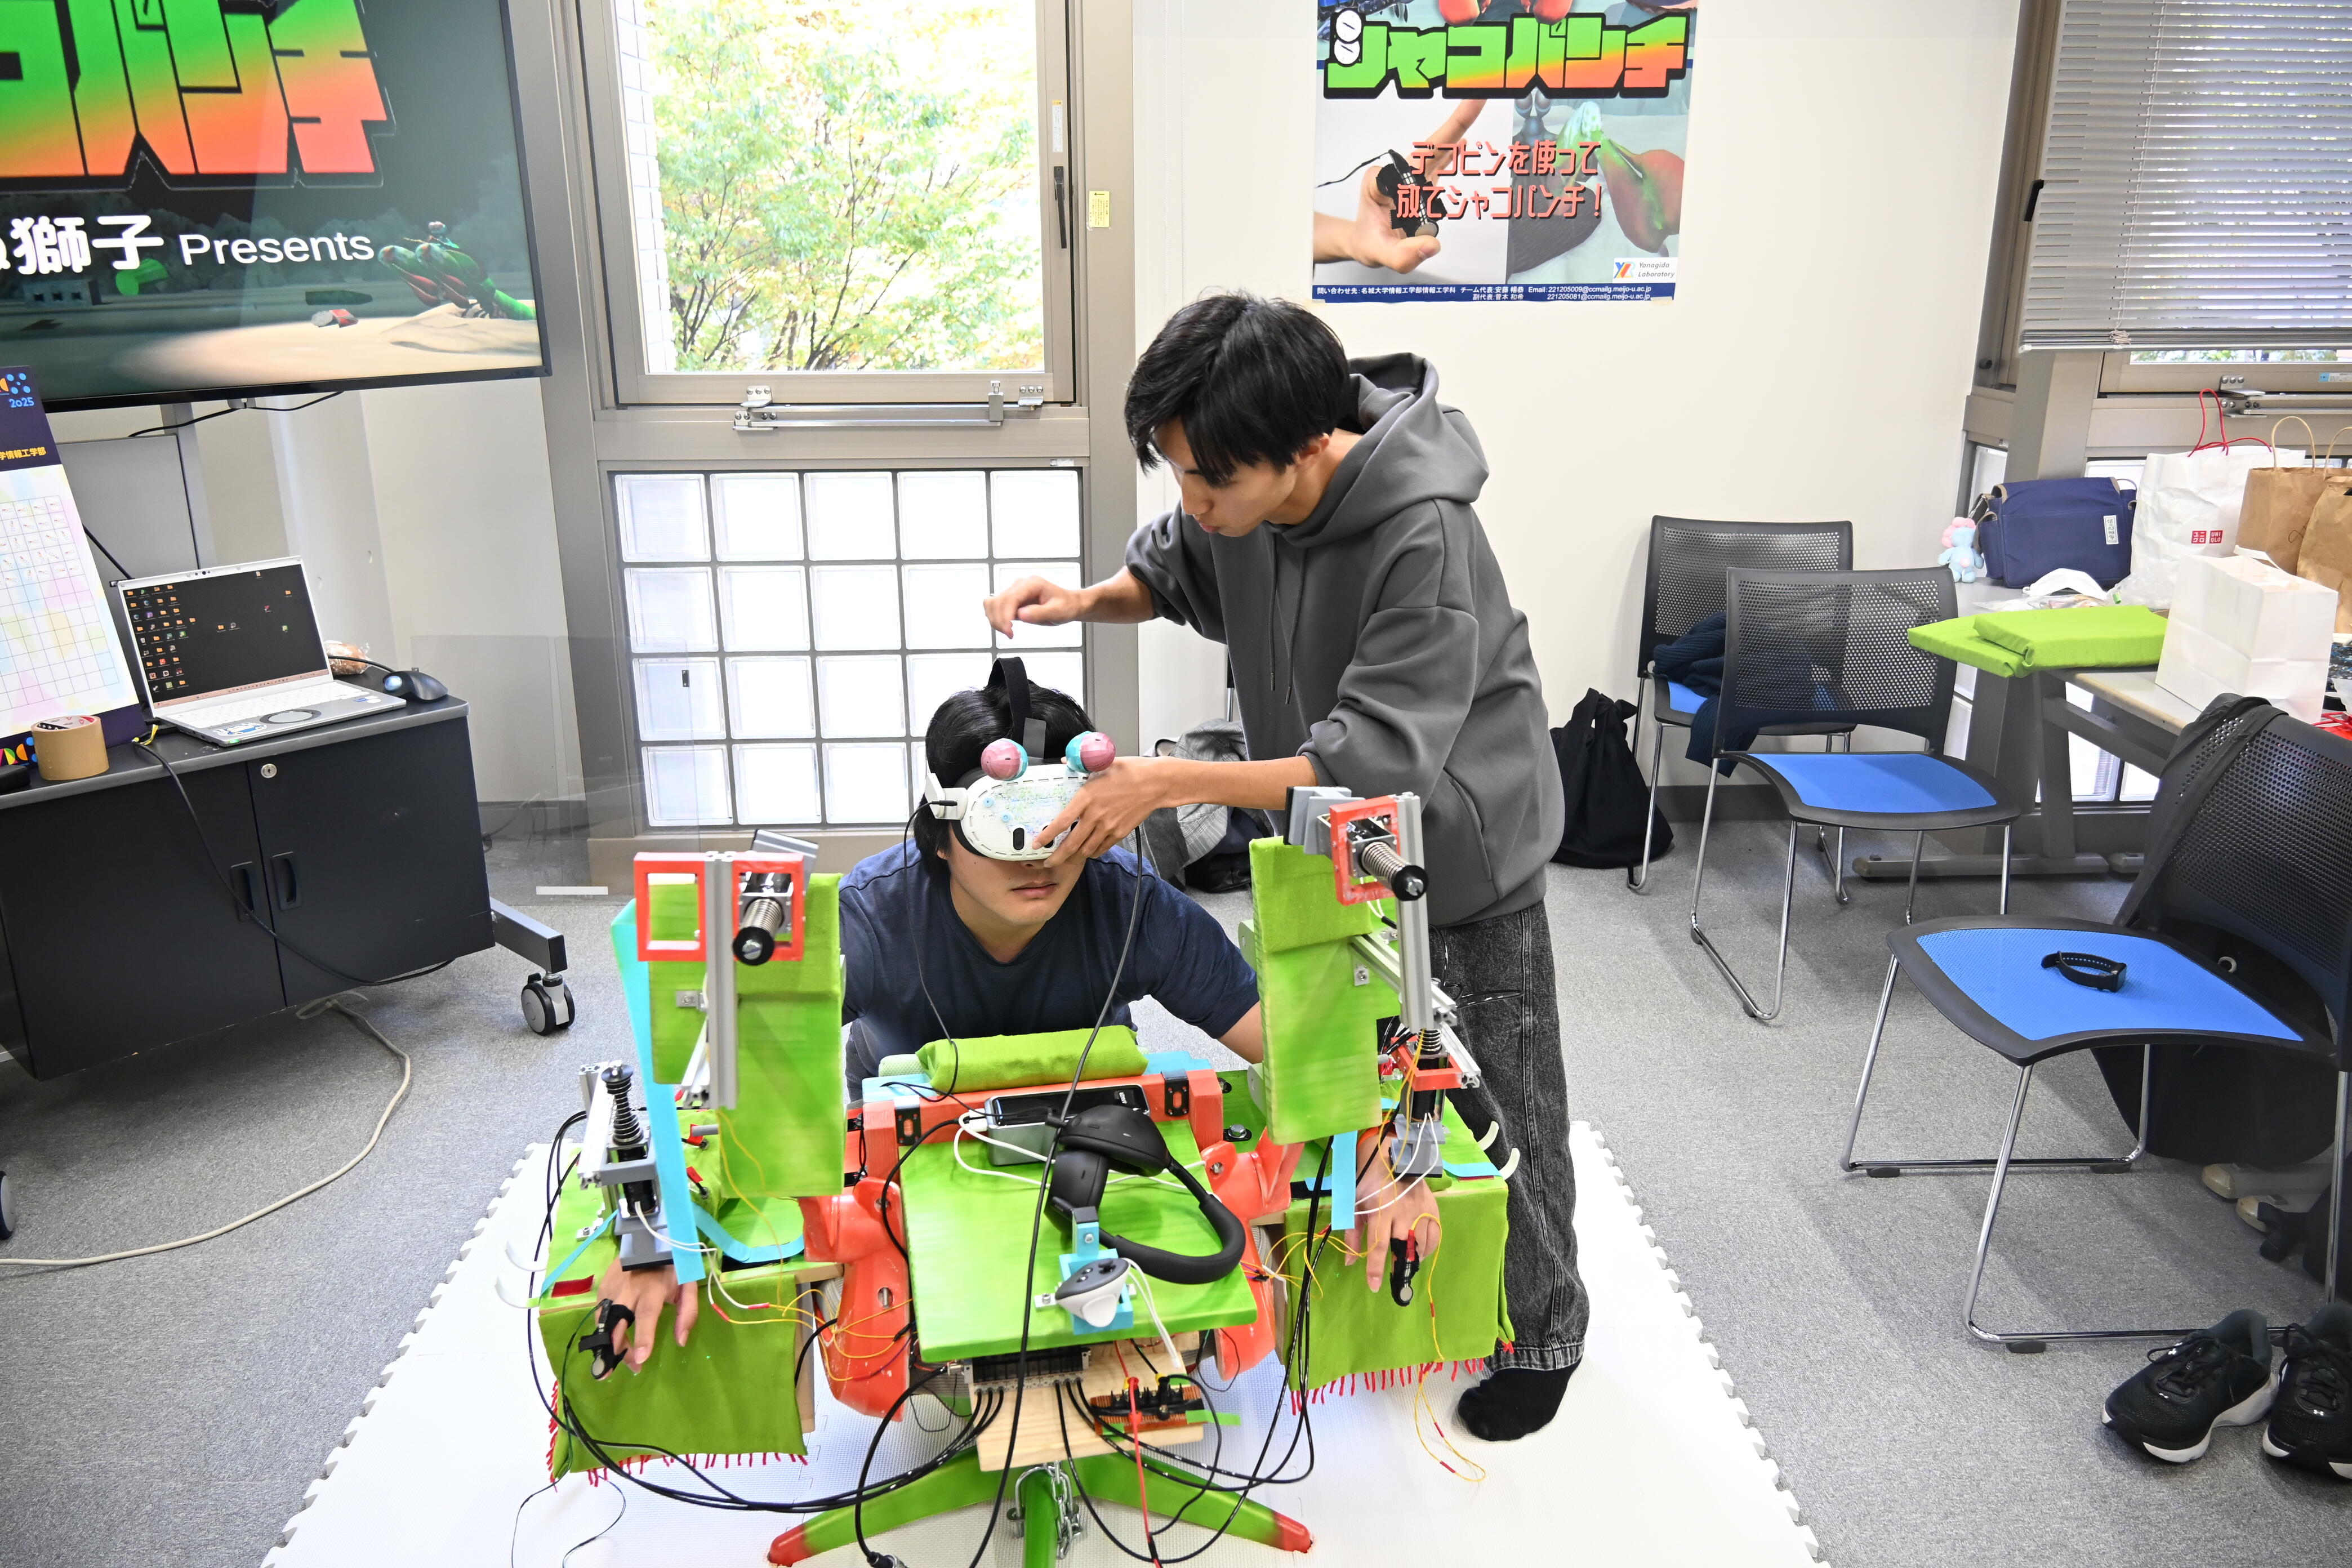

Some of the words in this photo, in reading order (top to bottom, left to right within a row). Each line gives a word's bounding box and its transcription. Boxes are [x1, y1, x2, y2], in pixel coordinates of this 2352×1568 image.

[1410, 139, 1601, 175] デコピンを使って
[1396, 183, 1602, 220] 放てシャコパンチ!
[180, 231, 375, 265] Presents
[9, 397, 34, 408] 2025
